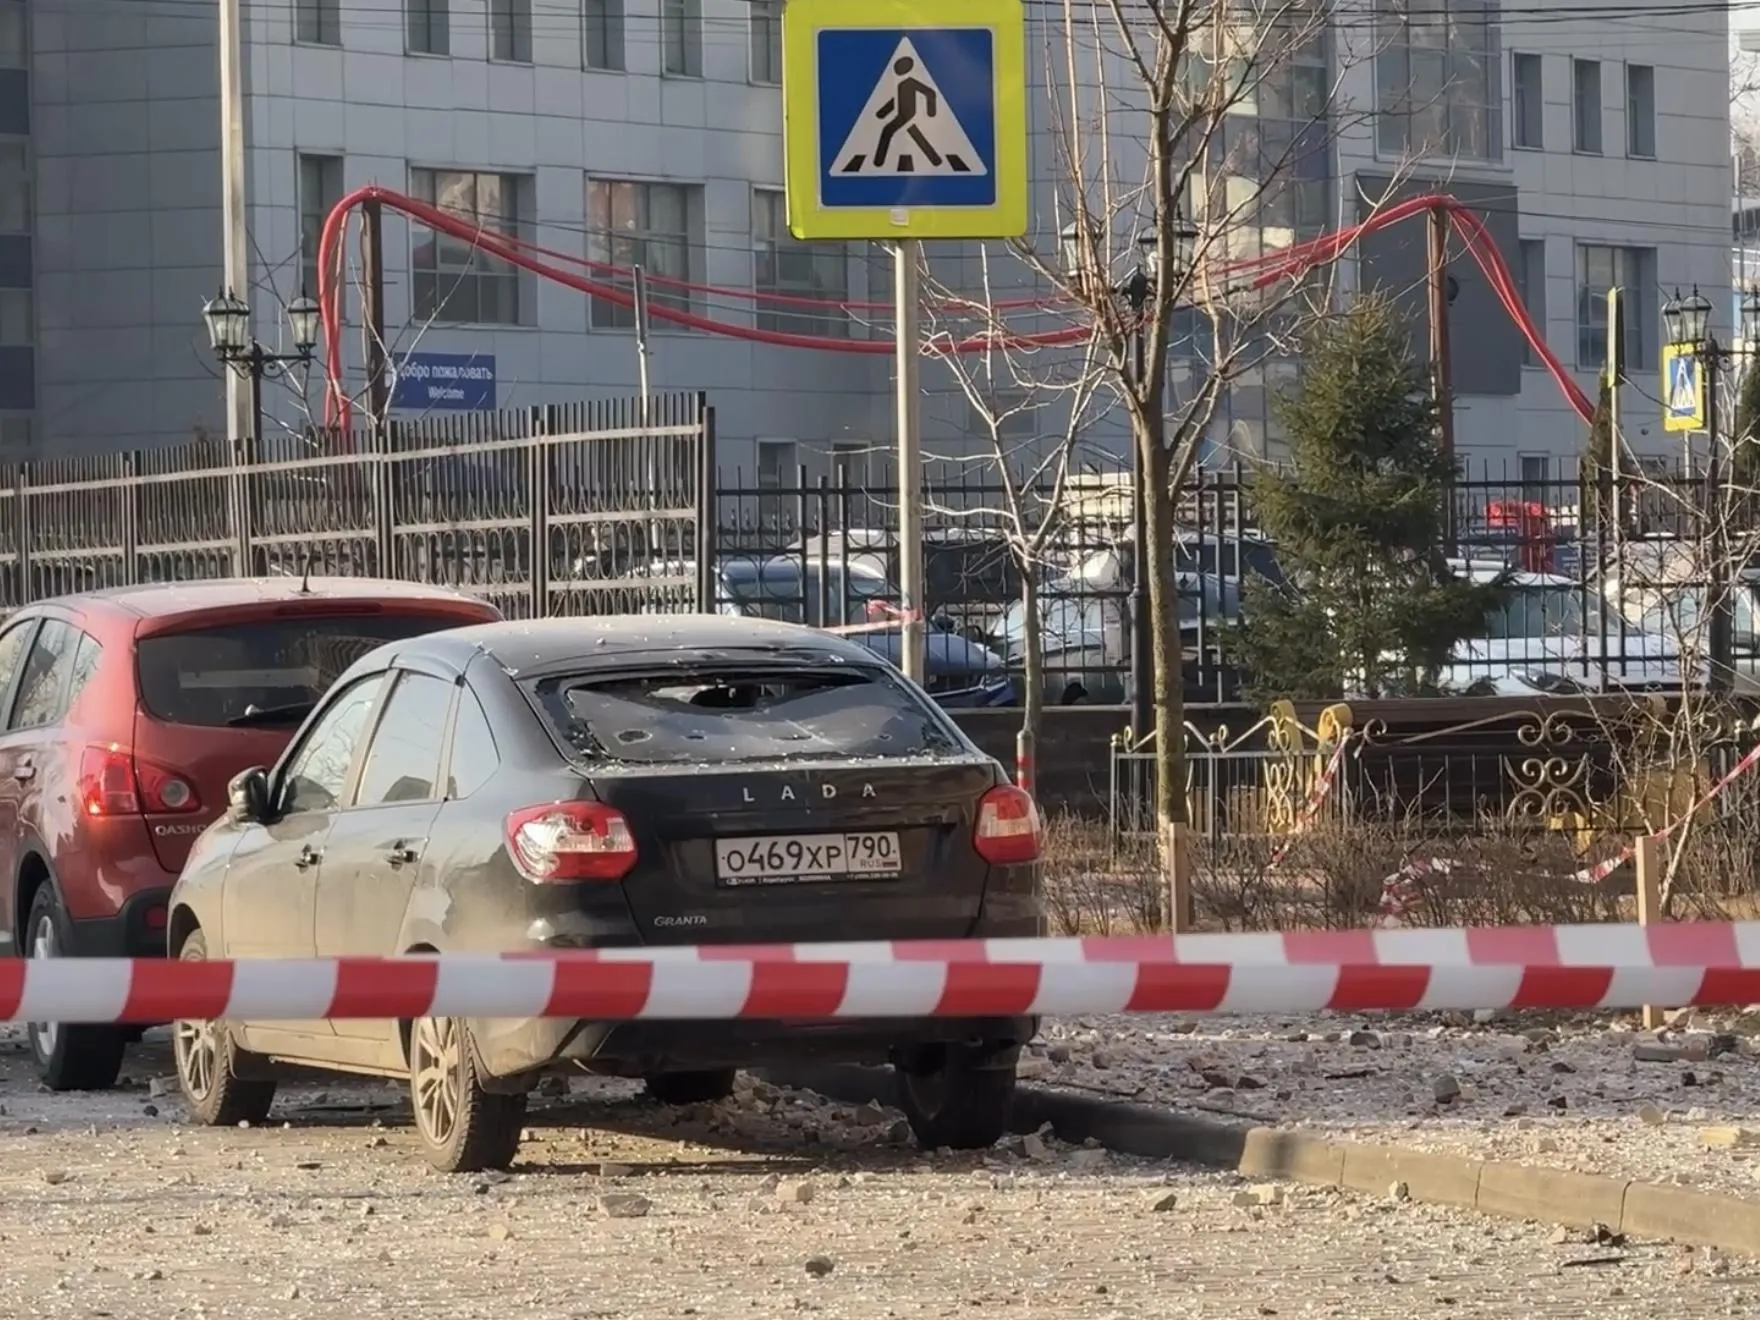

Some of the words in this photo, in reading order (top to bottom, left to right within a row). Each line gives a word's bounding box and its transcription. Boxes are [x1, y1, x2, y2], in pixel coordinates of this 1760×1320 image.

[743, 783, 877, 802] LADA
[847, 835, 890, 859] 790
[859, 858, 881, 868] RUS
[654, 915, 708, 927] GRANTA
